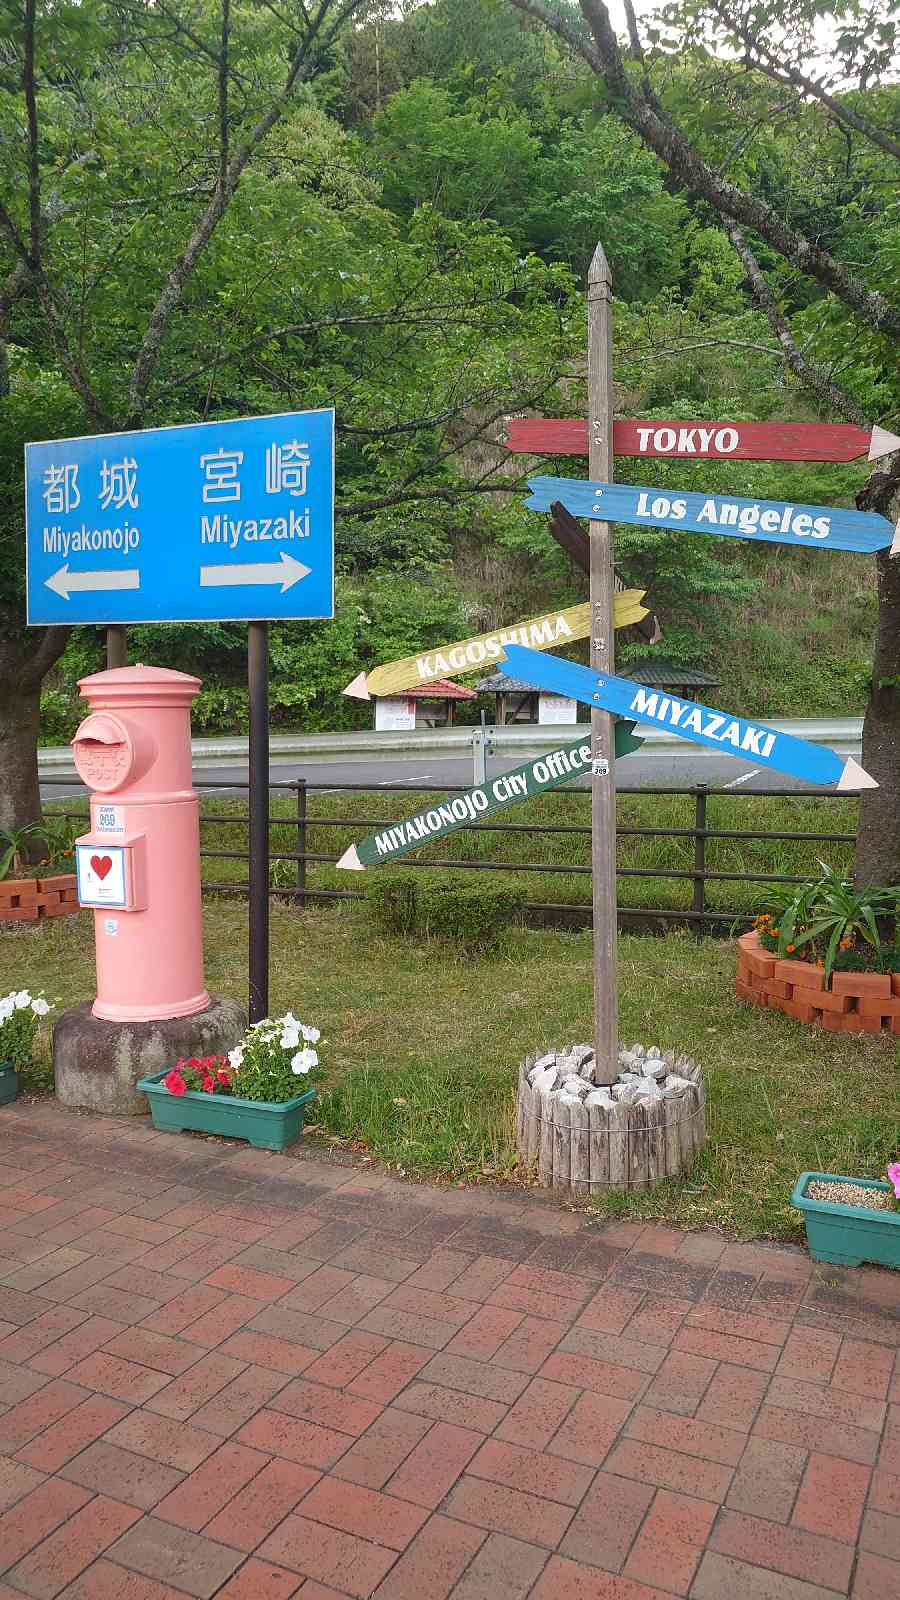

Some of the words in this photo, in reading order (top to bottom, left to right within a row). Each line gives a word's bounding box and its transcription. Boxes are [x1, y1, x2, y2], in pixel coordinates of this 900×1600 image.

[636, 428, 740, 453] TOKYO
[42, 455, 140, 514] 都城
[199, 439, 311, 504] 宮崎
[42, 521, 141, 558] Miyakonojo
[199, 507, 311, 549] Miyazaki
[636, 492, 687, 519] Los
[696, 499, 832, 539] Angeles
[415, 615, 574, 680] KAGOSHIMA
[629, 688, 777, 758] MIYAZAKI
[374, 789, 489, 856] MIYAKONOJO
[492, 772, 528, 803] City
[532, 744, 593, 785] Office
